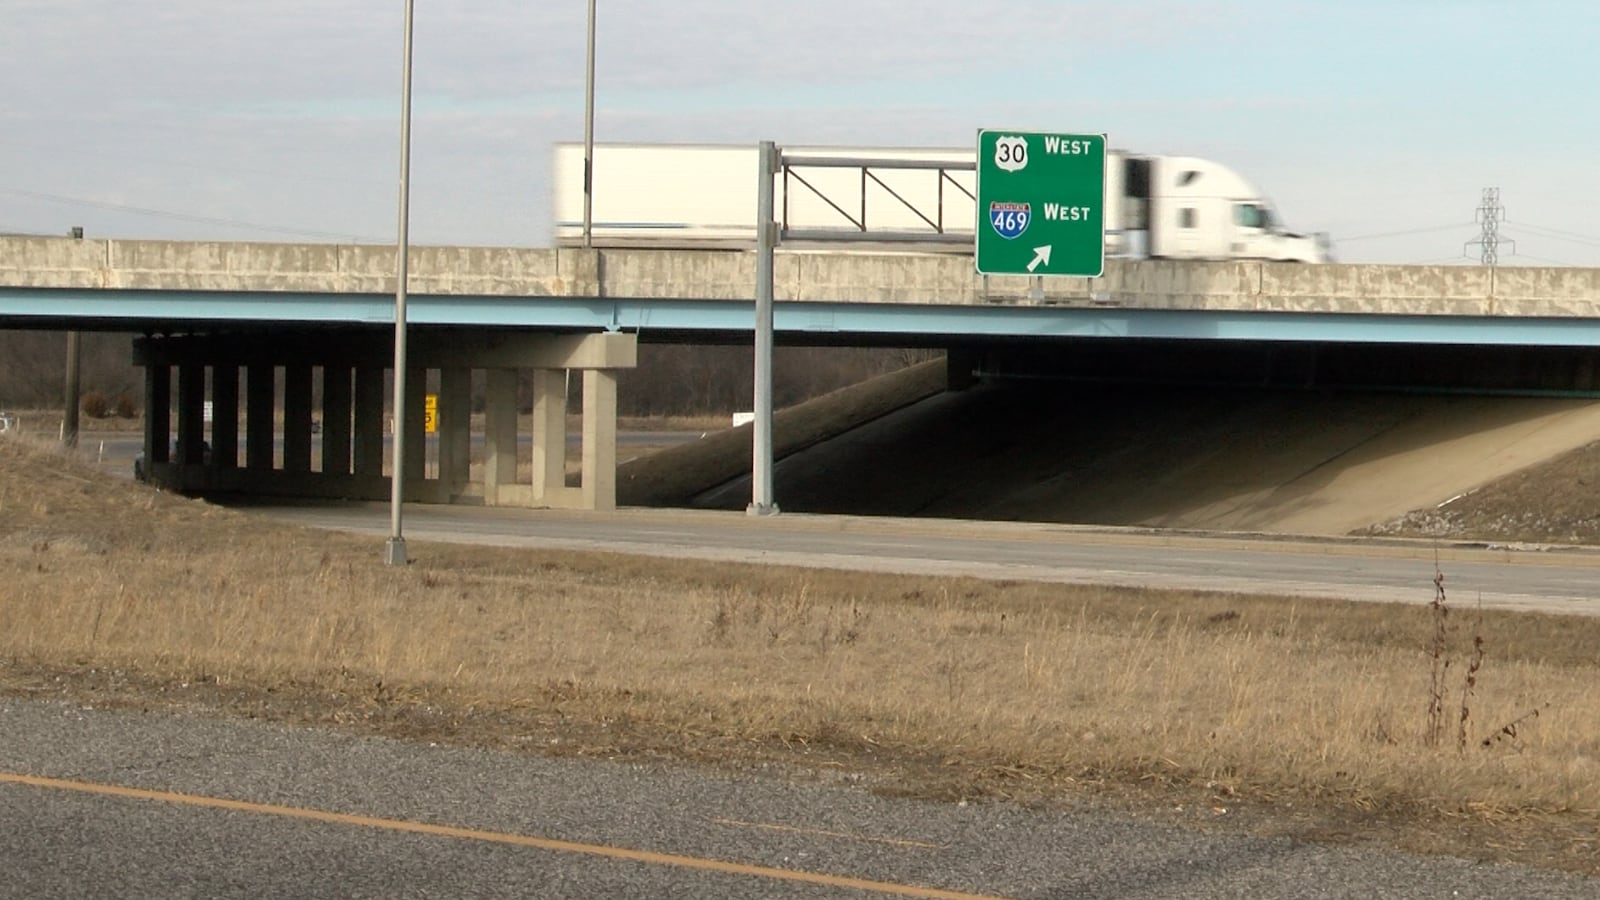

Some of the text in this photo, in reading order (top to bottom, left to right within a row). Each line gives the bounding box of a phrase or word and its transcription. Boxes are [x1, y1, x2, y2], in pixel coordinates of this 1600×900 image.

[999, 136, 1091, 162] 30 WEST
[994, 203, 1090, 231] 469 WEST
